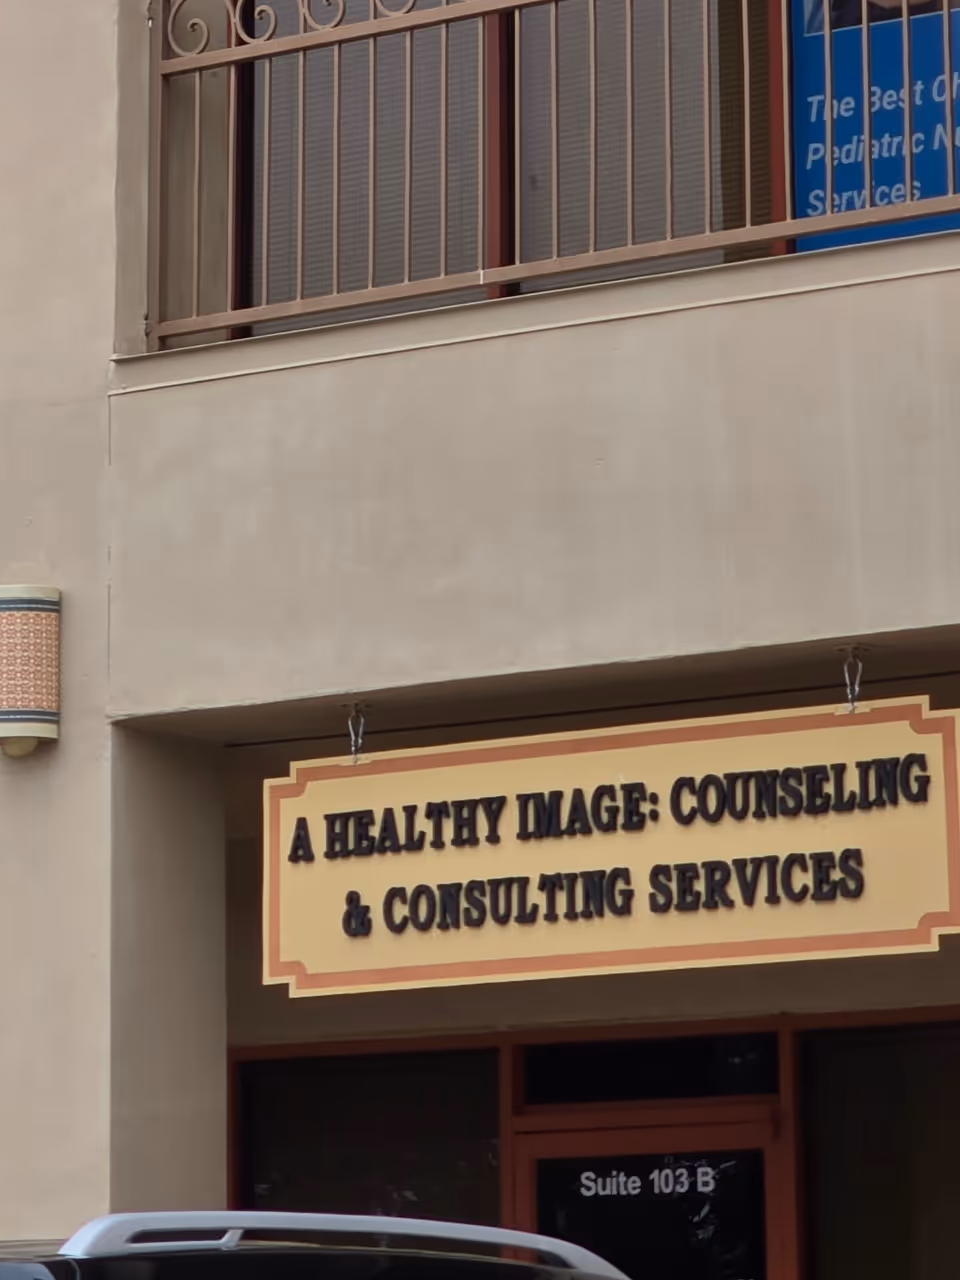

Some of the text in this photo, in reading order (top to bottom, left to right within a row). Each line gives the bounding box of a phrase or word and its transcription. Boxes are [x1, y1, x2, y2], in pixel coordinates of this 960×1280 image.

[806, 132, 925, 170] Pdiatrc
[806, 180, 921, 216] Srvces
[288, 753, 931, 862] A HEALTHY IMAGE: COUNSELING
[342, 848, 865, 937] & CONSULTING SERVICES
[580, 1167, 716, 1197] Suite 103 B
